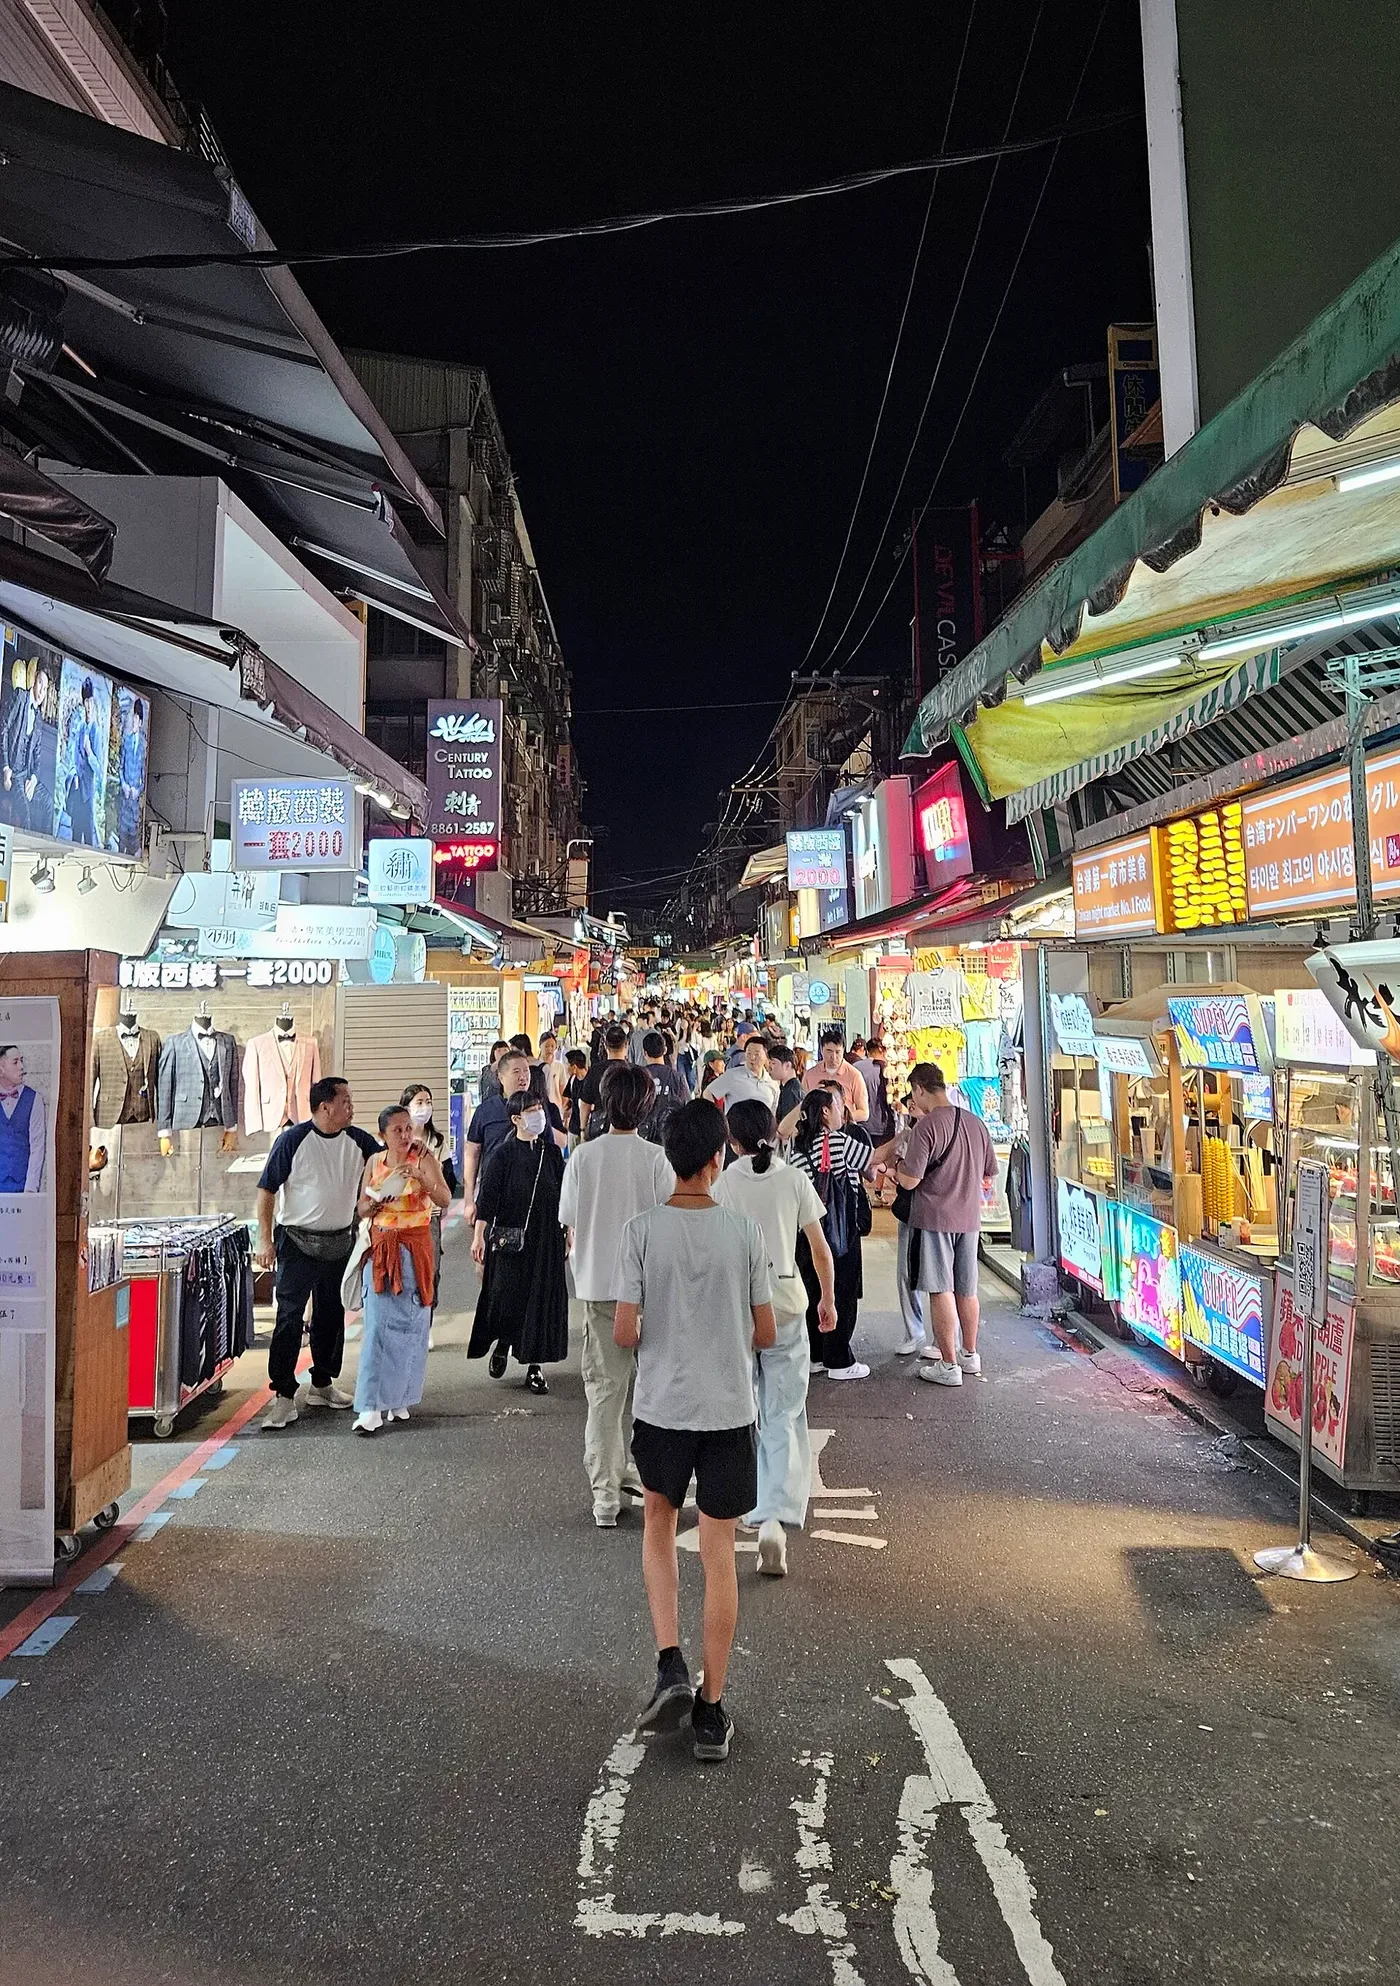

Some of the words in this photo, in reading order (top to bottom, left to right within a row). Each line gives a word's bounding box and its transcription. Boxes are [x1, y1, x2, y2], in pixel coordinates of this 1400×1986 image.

[434, 749, 489, 763] CENTURY
[447, 764, 493, 779] TATTOO
[239, 787, 345, 825] 韓版西裝
[444, 790, 481, 817] 刺青
[431, 821, 495, 835] 8861-2587
[243, 830, 342, 860] 一套2000
[450, 845, 494, 858] TATTOO
[464, 856, 479, 867] 2F
[1250, 862, 1280, 894] 타이완
[1282, 853, 1315, 888] 최고의
[1317, 844, 1355, 882] 야시장
[795, 868, 841, 886] 2000
[1135, 892, 1152, 913] Food
[1193, 1006, 1230, 1036] SUPER
[1202, 1268, 1239, 1321] SUPER
